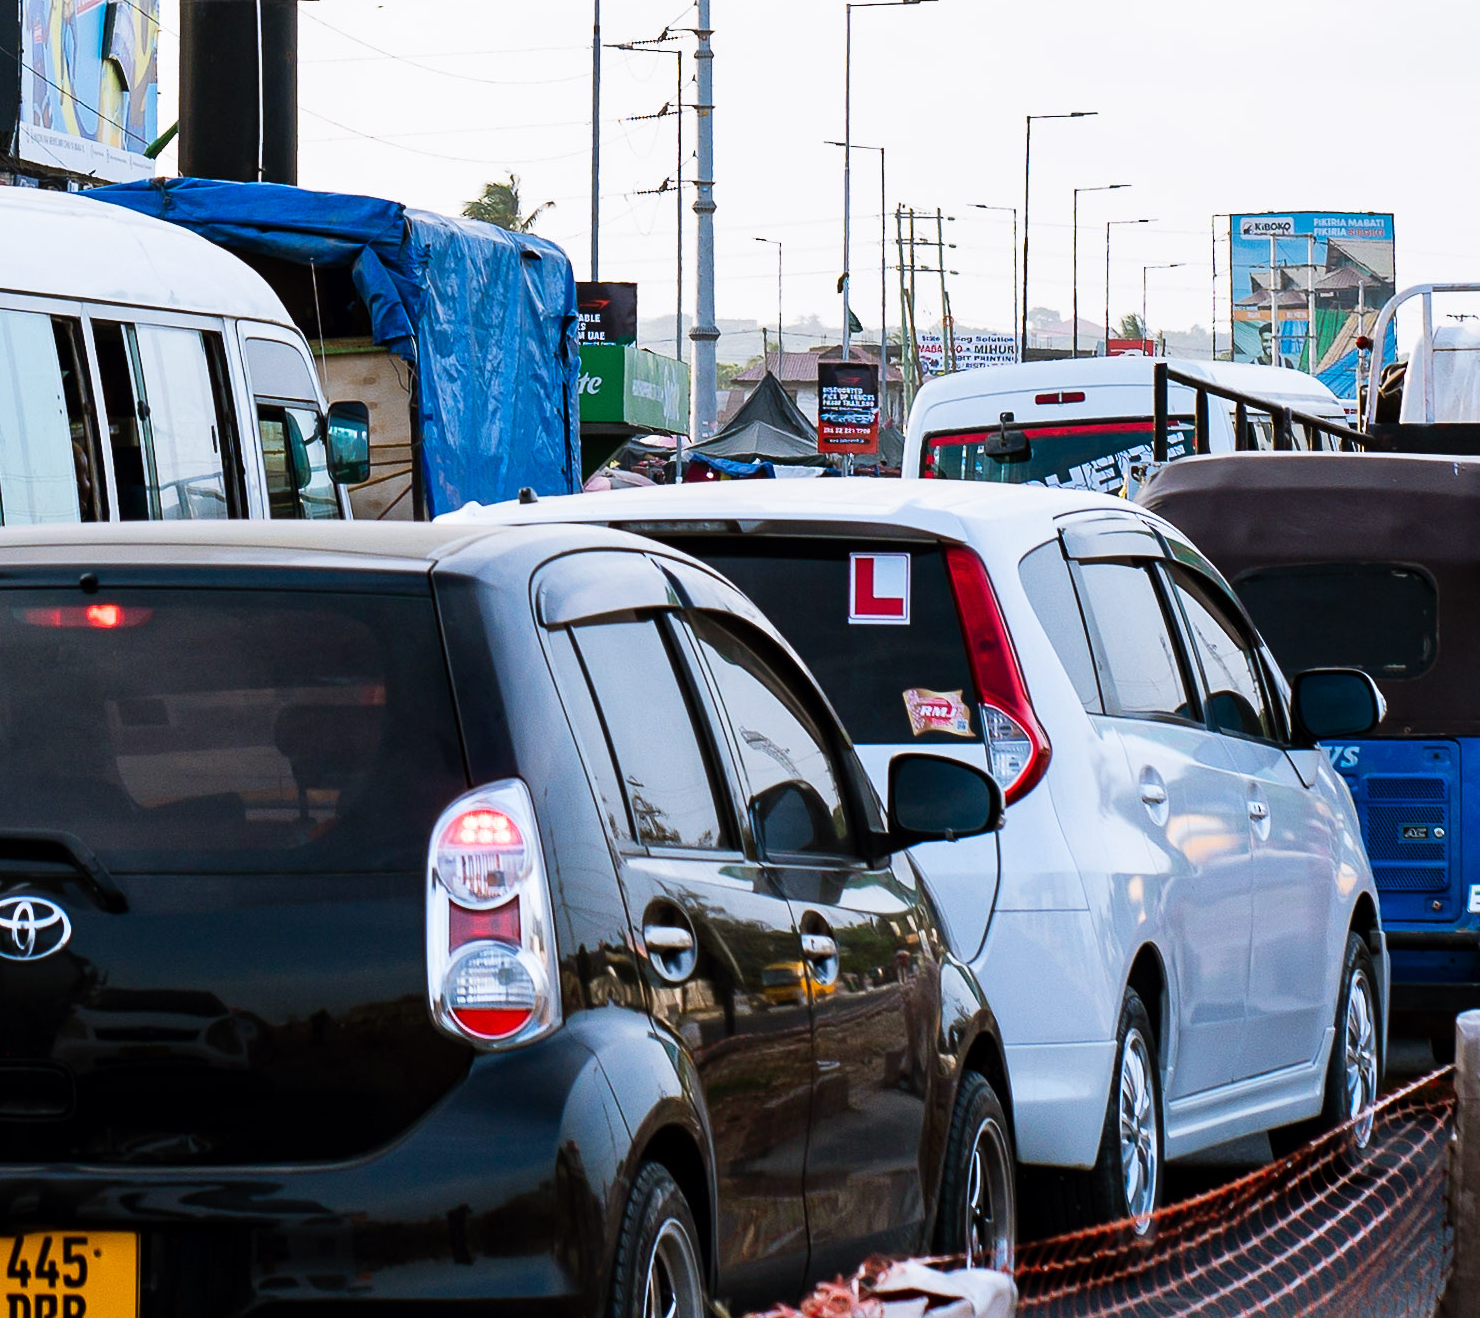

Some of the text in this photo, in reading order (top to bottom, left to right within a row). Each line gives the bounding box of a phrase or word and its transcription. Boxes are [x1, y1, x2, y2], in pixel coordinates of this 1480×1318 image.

[974, 344, 1015, 354] MIHUR
[853, 556, 906, 618] L
[919, 705, 957, 718] RMJ
[1322, 745, 1361, 769] VS
[6, 1234, 89, 1290] 445
